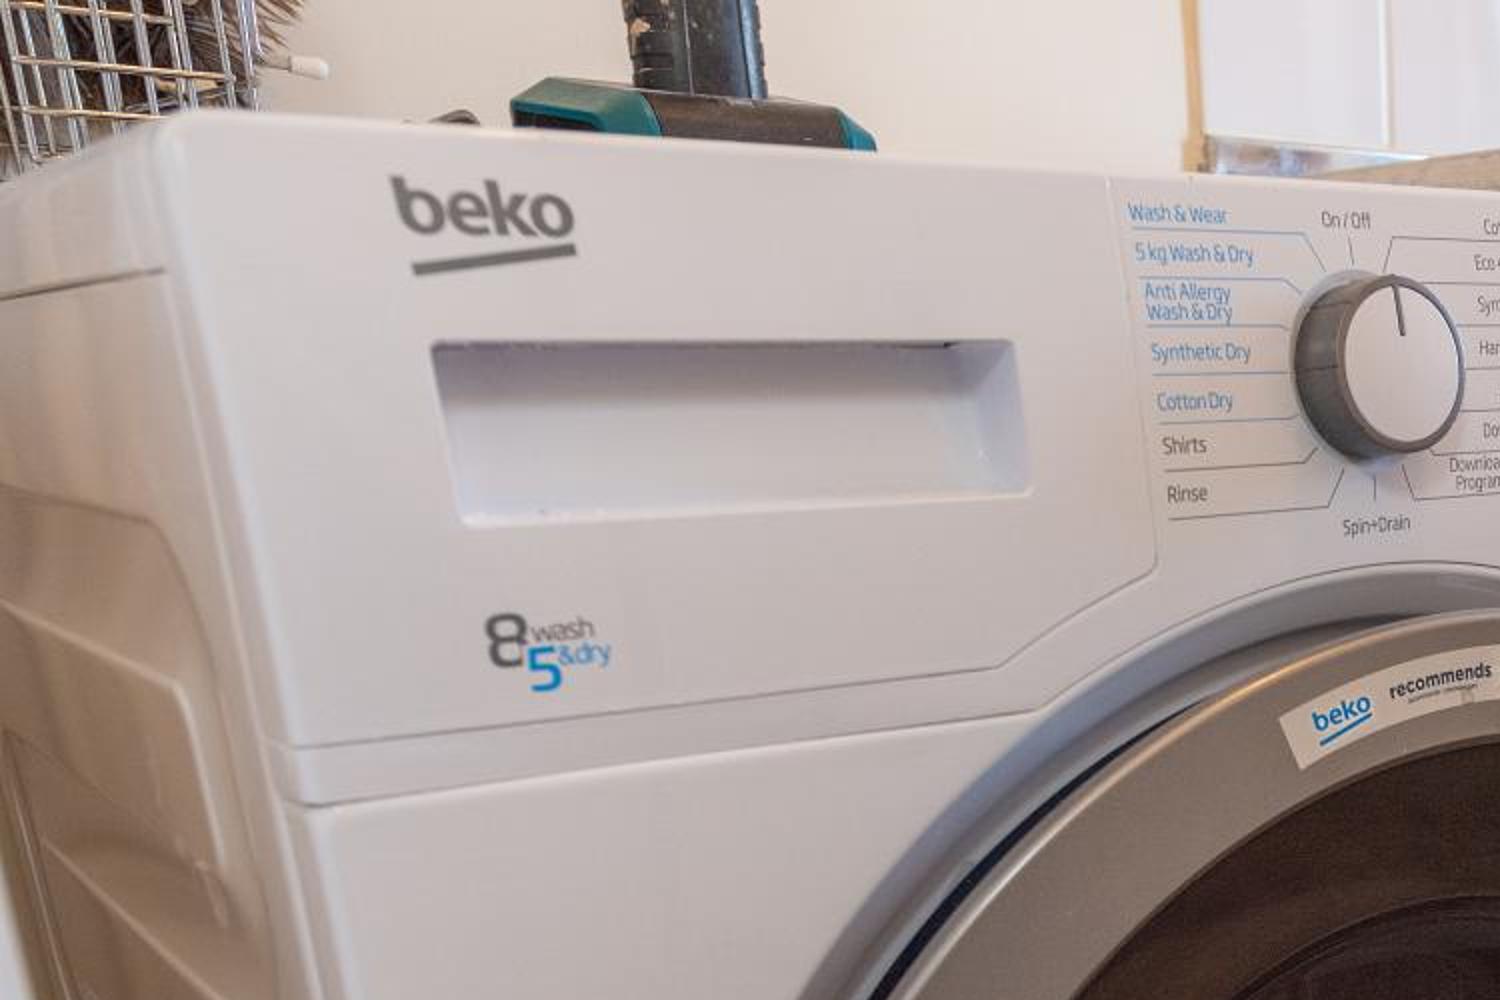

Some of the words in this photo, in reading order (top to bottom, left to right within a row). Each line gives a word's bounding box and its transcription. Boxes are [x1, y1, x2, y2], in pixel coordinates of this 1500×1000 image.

[390, 174, 575, 239] beko
[1127, 203, 1170, 221] Wash
[1174, 204, 1186, 222] &
[1189, 206, 1227, 223] Wear
[1321, 211, 1341, 228] On
[1351, 211, 1371, 229] Off
[1135, 241, 1144, 261] 5
[1146, 241, 1167, 265] kg
[1169, 243, 1212, 262] Wash
[1214, 244, 1226, 261] &
[1228, 245, 1253, 268] Dry
[1474, 254, 1496, 272] Eco
[1145, 282, 1176, 300] Anti
[1180, 282, 1231, 304] Allergy
[1146, 303, 1188, 320] Wash
[1191, 303, 1203, 320] &
[1206, 304, 1232, 326] Dry
[1152, 343, 1223, 365] Synthetic
[1225, 342, 1251, 364] Dry
[1157, 392, 1207, 411] Cotton
[1208, 391, 1233, 413] Dry
[1162, 436, 1208, 455] Shirts
[1167, 485, 1208, 503] Rinse
[484, 612, 527, 669] 8
[531, 615, 596, 642] wash
[528, 645, 562, 693] 5
[1311, 695, 1372, 732] beko
[1389, 661, 1493, 700] recommends
